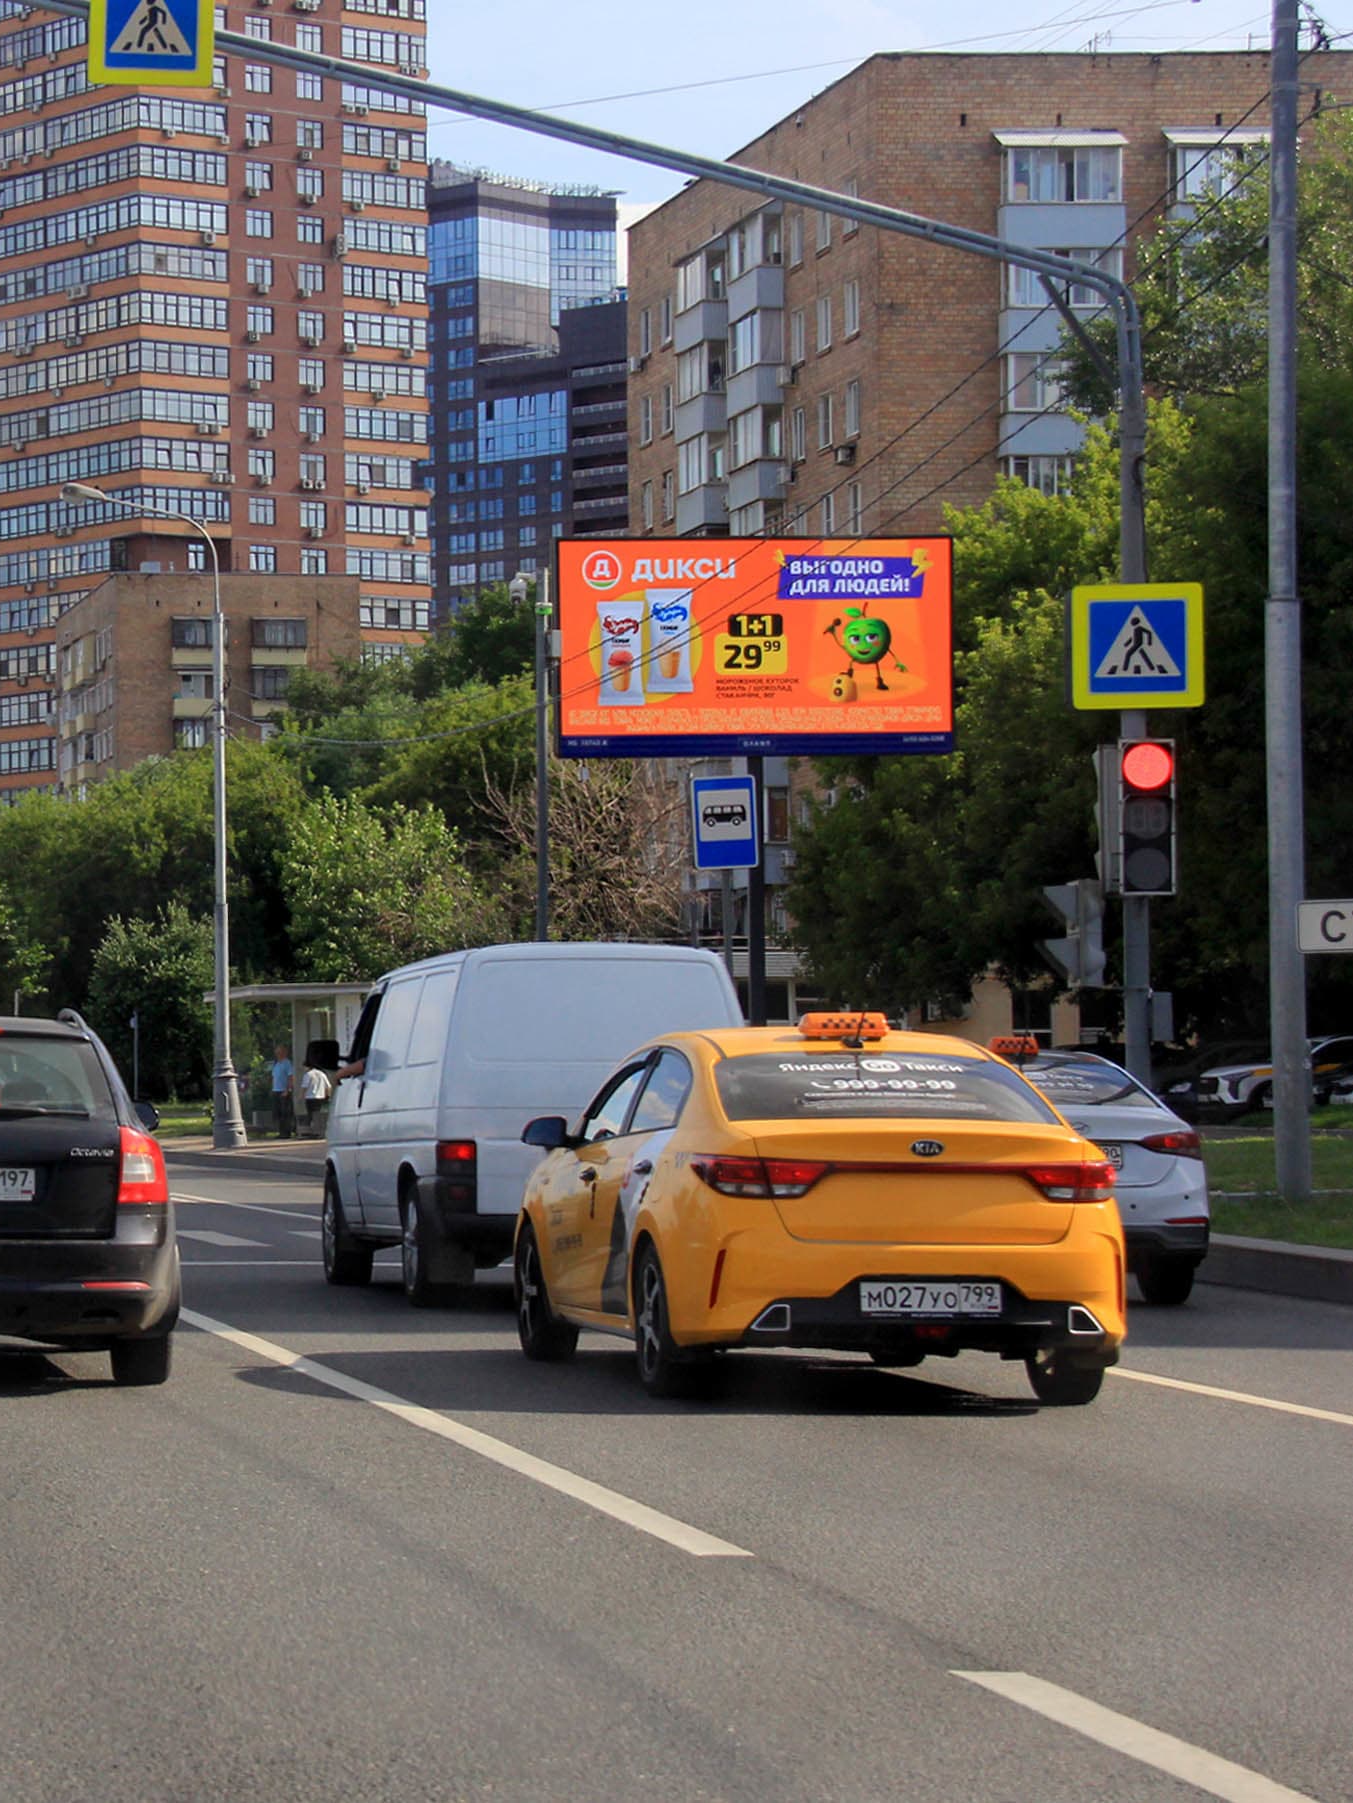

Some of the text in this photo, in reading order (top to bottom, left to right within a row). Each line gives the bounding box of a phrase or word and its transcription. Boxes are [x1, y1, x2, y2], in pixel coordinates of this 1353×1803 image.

[789, 559, 884, 577] ВЫГОДНО
[789, 574, 911, 596] ДЛЯ ЛЮДЕЙ!
[735, 615, 773, 636] 1+1
[724, 640, 781, 669] 29 99
[1320, 910, 1353, 943] С
[779, 1062, 858, 1073] Яндекс
[902, 1061, 964, 1074] Такси
[833, 1079, 957, 1090] 999-99-99
[914, 1143, 940, 1153] KIA
[961, 1285, 996, 1303] 799
